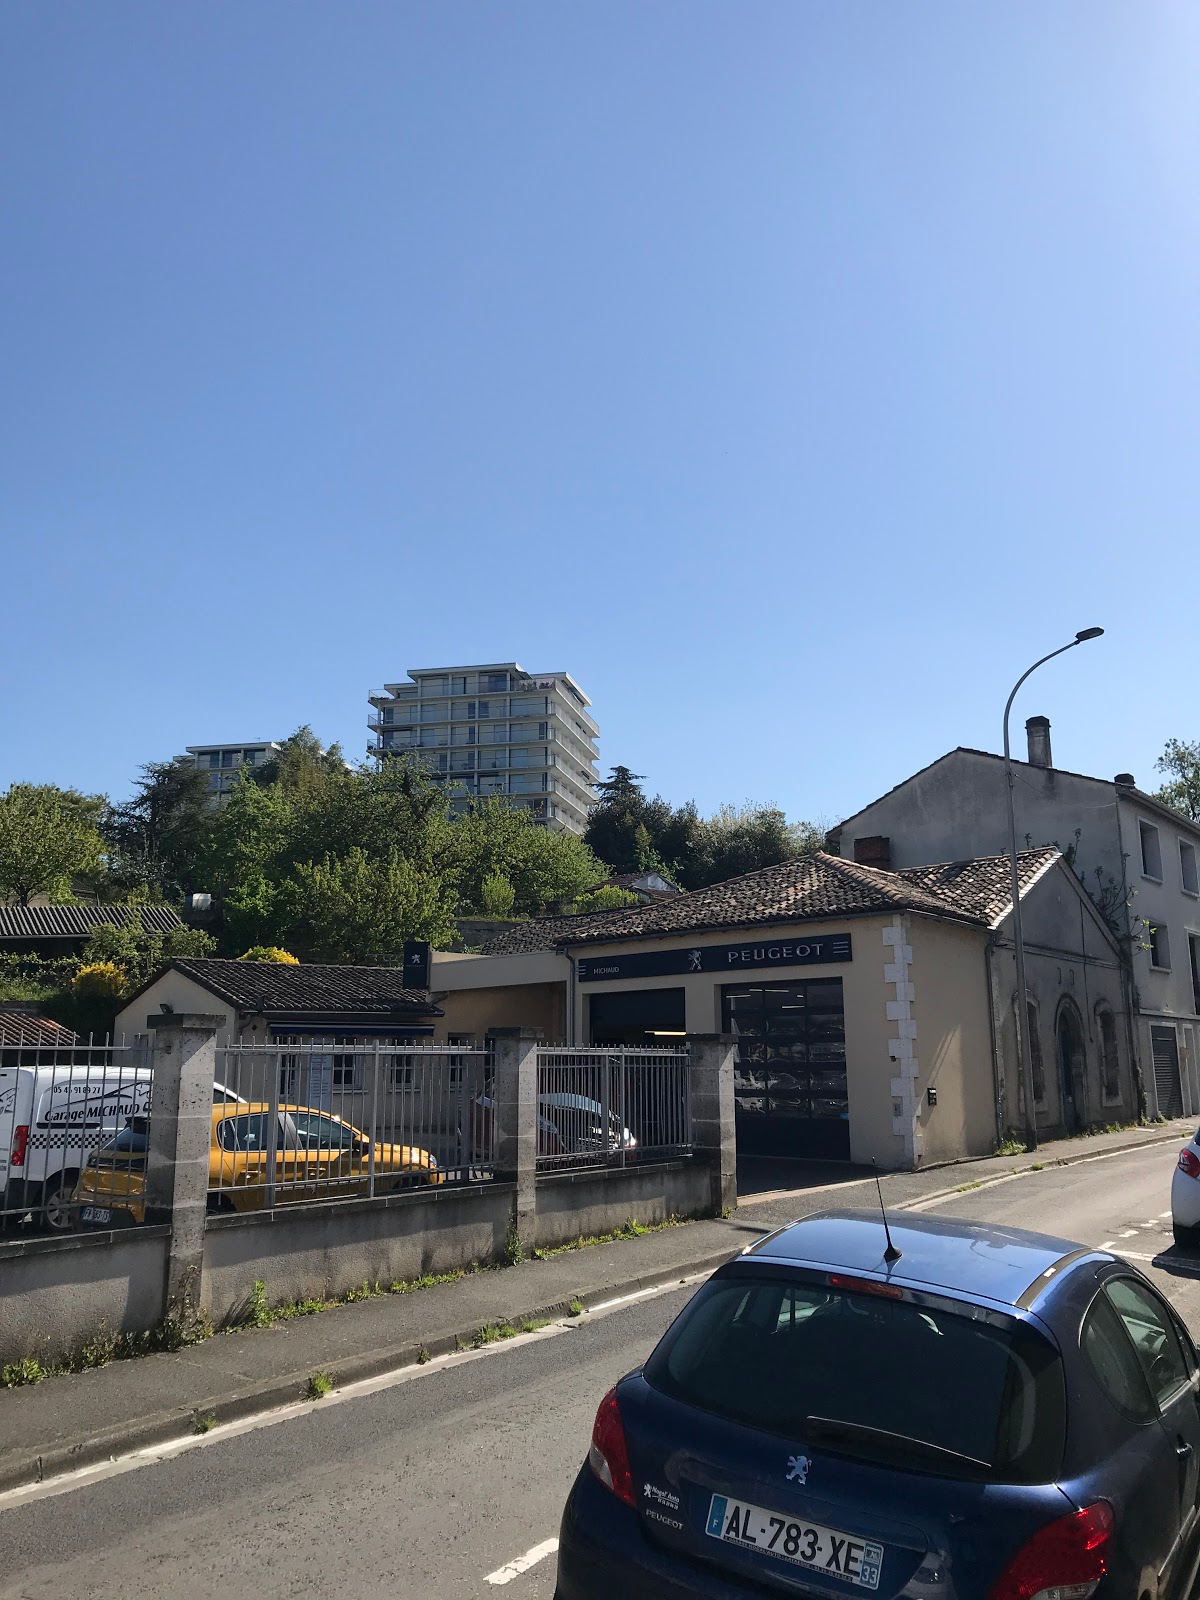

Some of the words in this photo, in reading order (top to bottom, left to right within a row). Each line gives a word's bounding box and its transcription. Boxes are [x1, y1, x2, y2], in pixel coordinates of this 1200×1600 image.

[728, 943, 824, 962] PEUGEOT
[593, 966, 620, 975] MICHAUD
[45, 1110, 84, 1122] Garage
[86, 1103, 140, 1118] MICHAUD
[646, 1509, 684, 1530] PEUGEOT
[712, 1519, 719, 1528] F
[861, 1565, 878, 1584] 33
